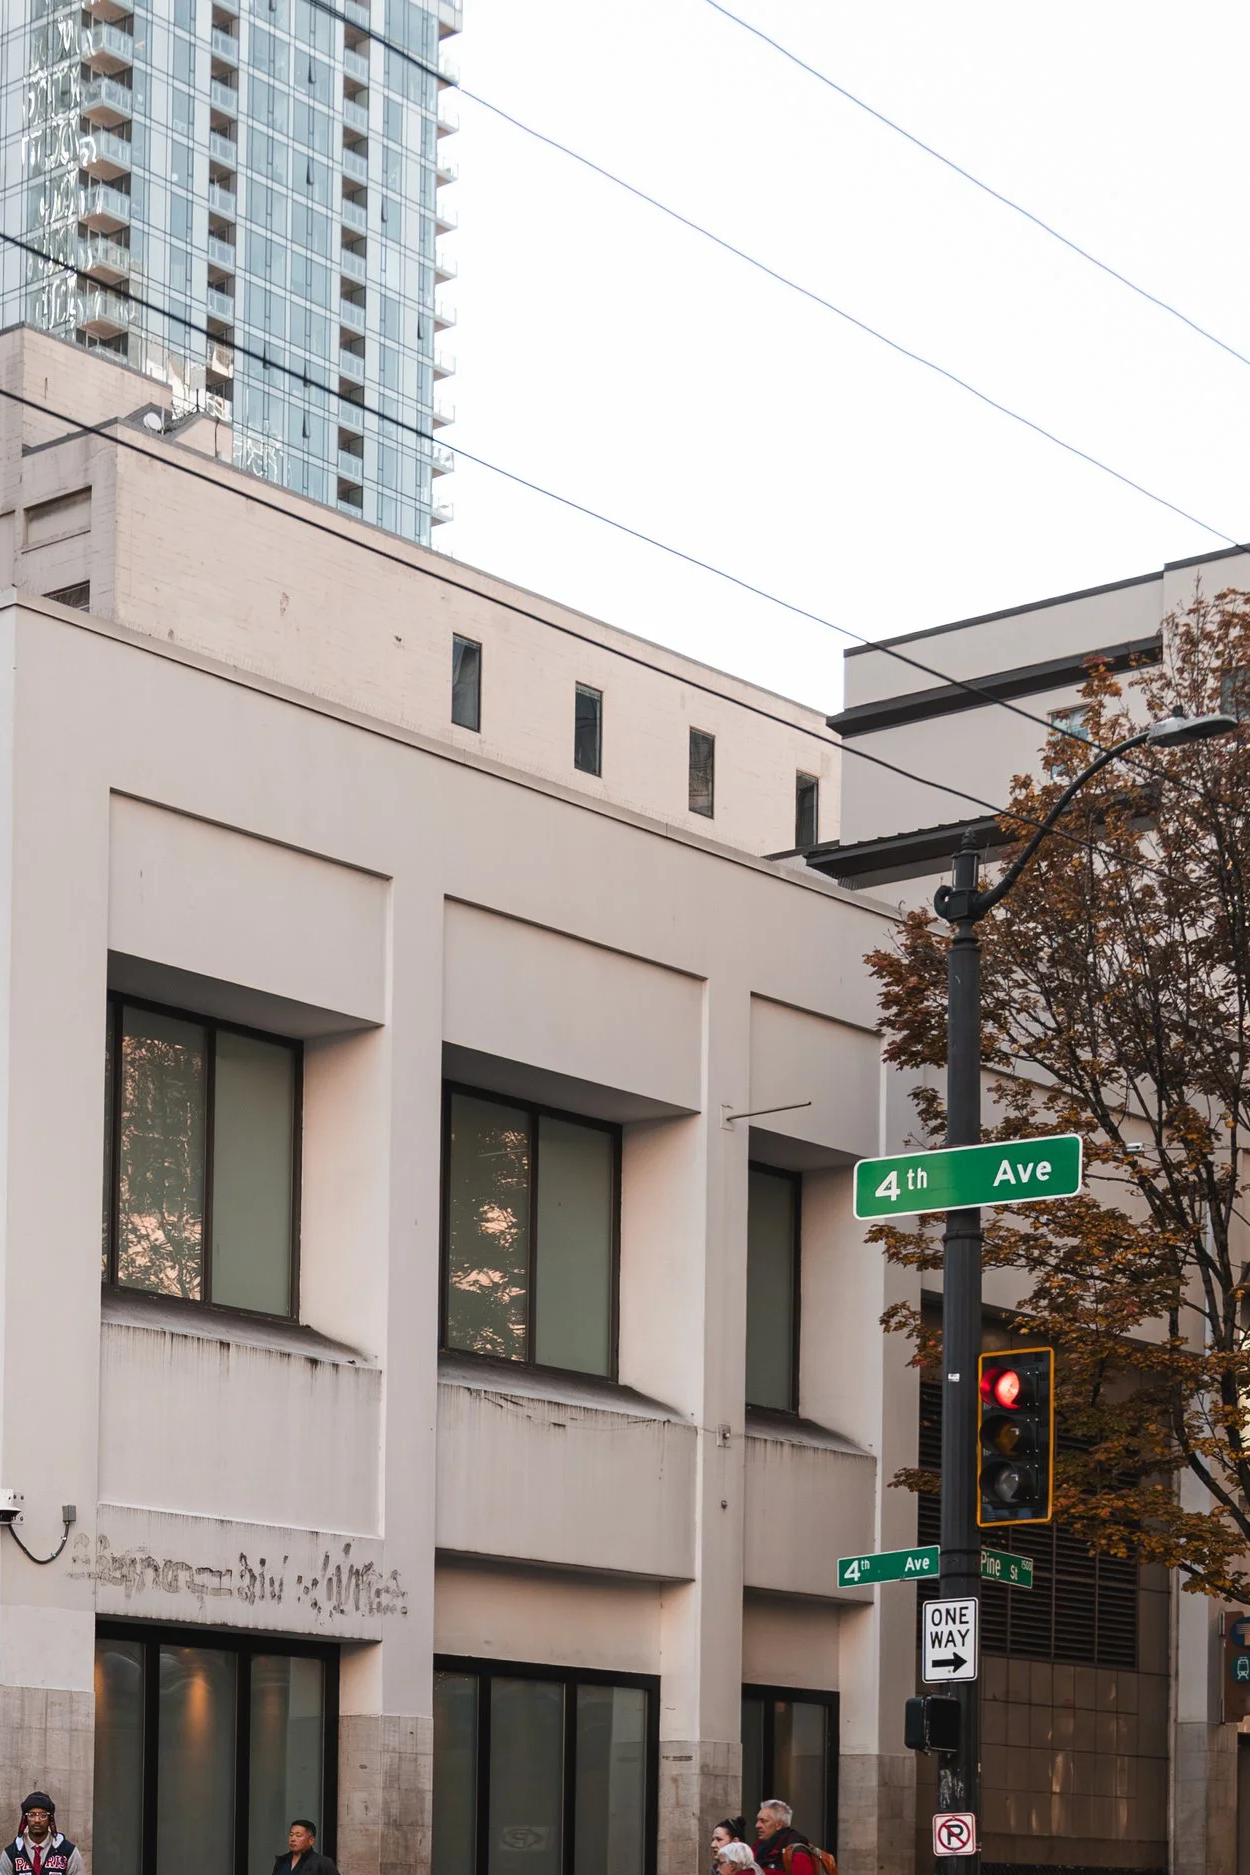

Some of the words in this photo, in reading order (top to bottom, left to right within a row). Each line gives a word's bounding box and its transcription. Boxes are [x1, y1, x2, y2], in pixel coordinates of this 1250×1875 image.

[875, 1167, 927, 1201] 4th
[993, 1159, 1052, 1187] Ave
[844, 1559, 870, 1581] 4th
[904, 1557, 930, 1572] Ave
[980, 1551, 1001, 1576] Pine
[1010, 1564, 1019, 1580] St
[931, 1606, 969, 1627] ONE
[930, 1628, 970, 1649] WAY
